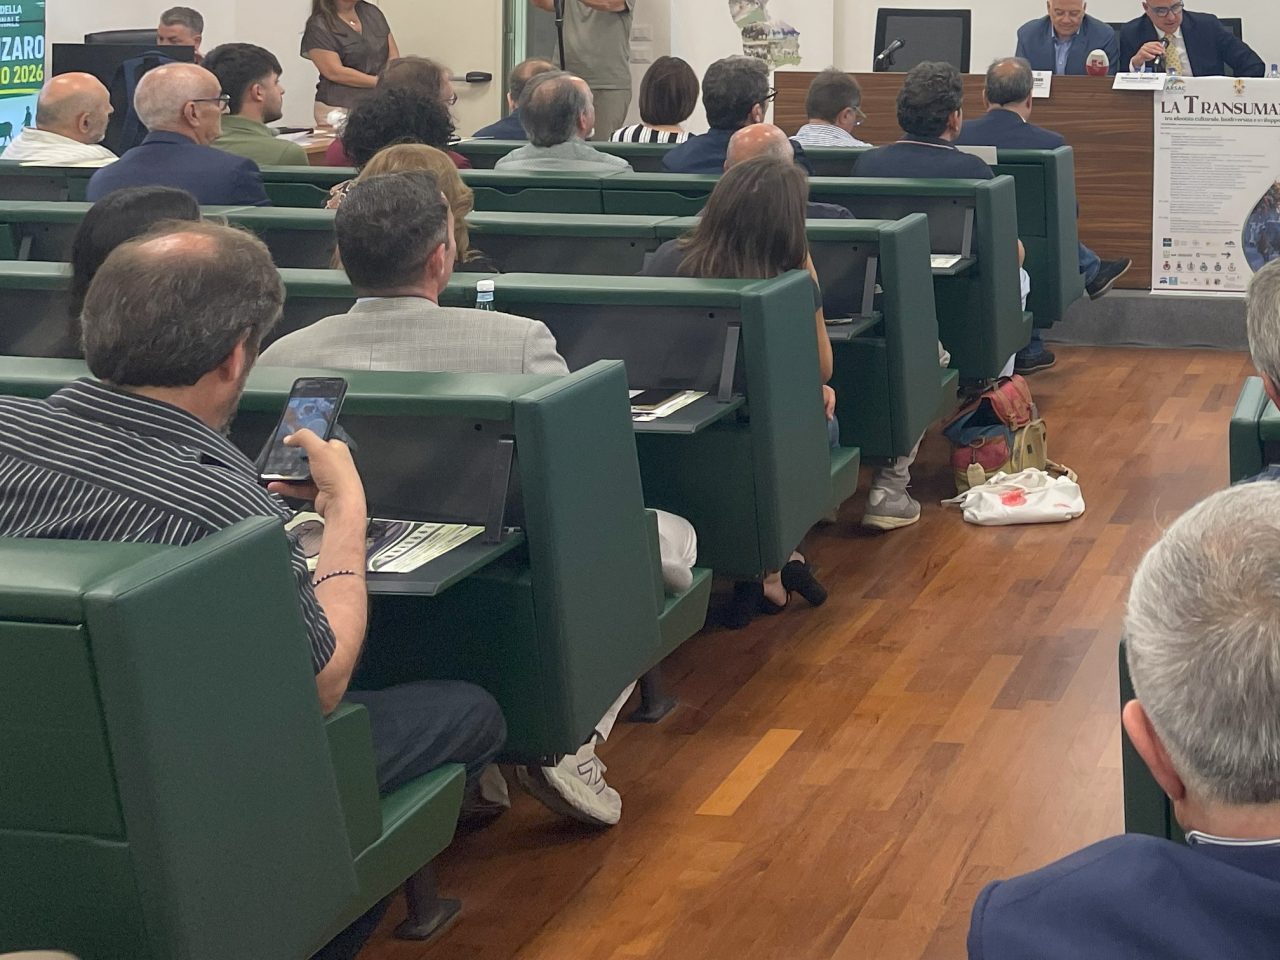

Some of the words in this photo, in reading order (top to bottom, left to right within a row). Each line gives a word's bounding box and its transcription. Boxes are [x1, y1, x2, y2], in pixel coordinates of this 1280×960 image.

[0, 35, 45, 61] ZARO
[14, 64, 43, 84] 2026
[1161, 101, 1181, 114] LA
